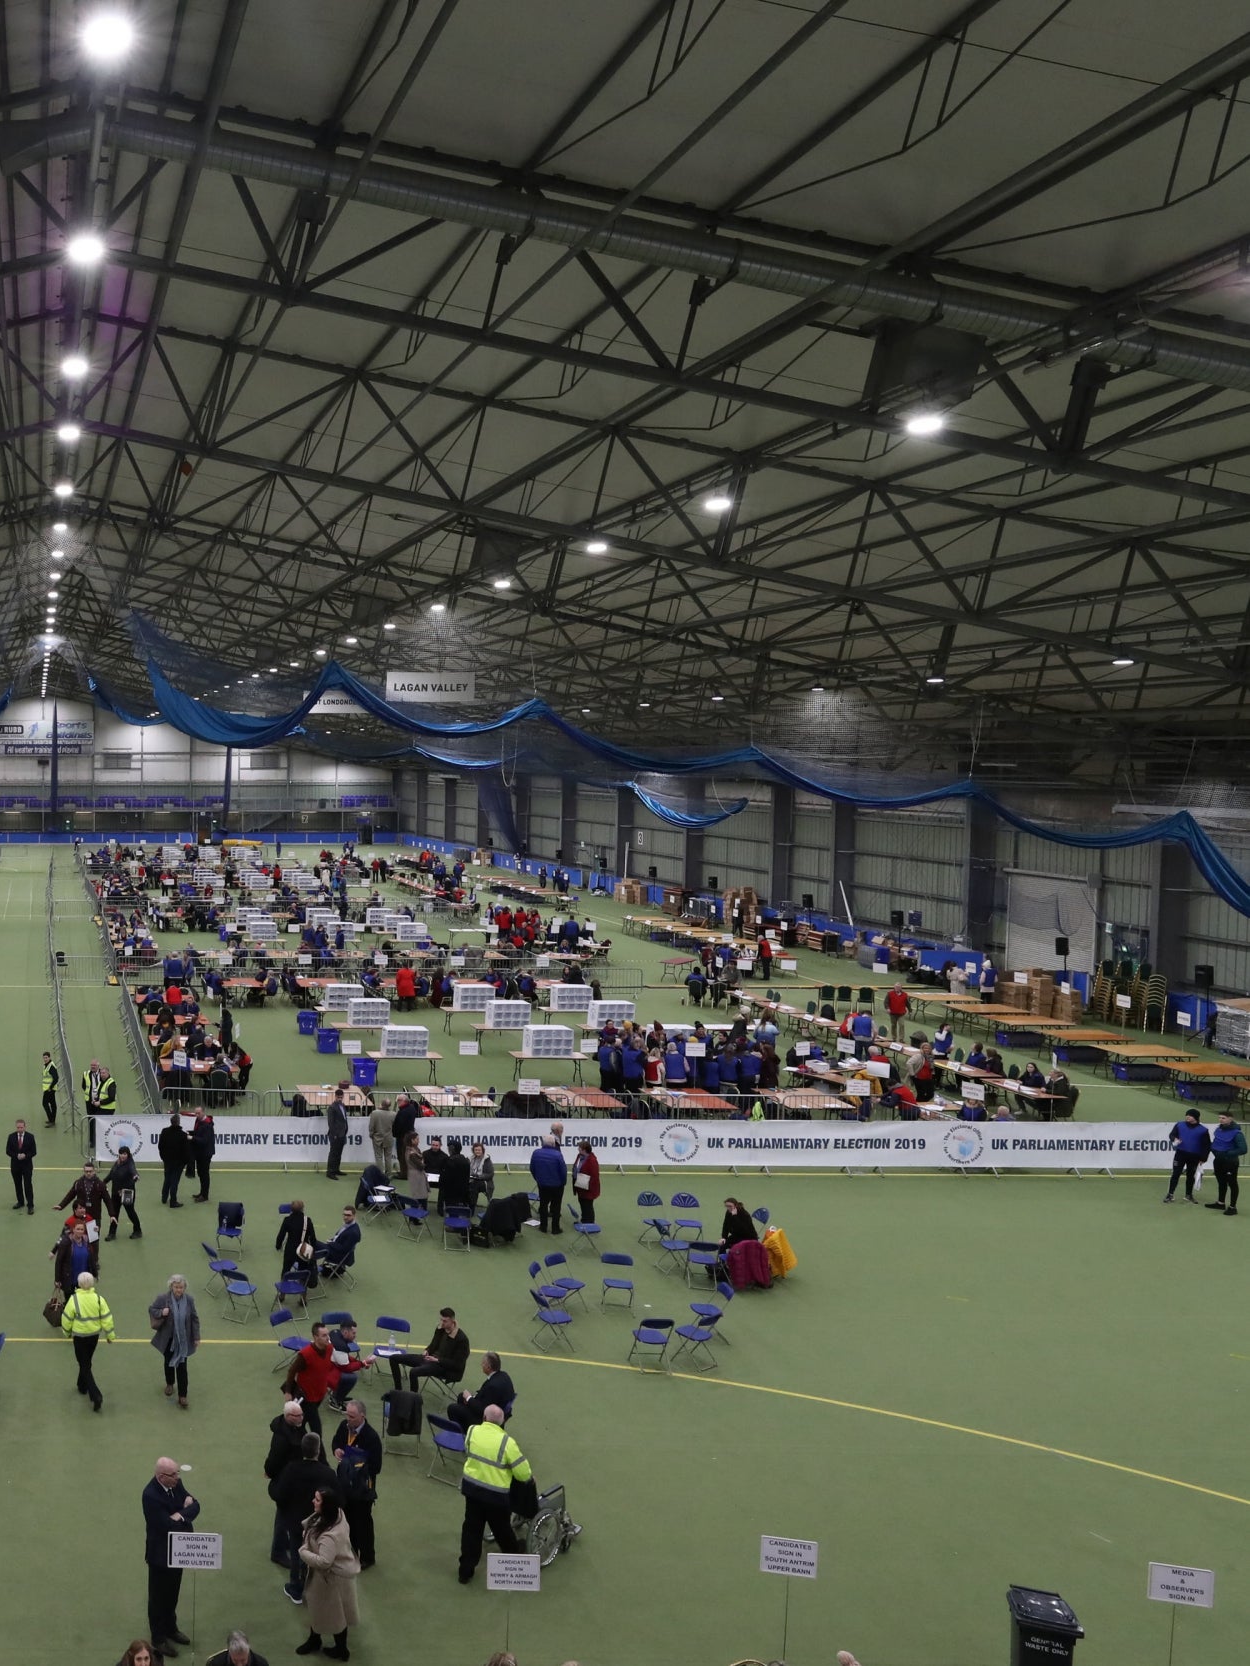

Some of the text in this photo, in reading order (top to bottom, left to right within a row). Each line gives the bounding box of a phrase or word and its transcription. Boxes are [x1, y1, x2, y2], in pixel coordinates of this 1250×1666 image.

[394, 683, 468, 692] LAGAN VALLEY
[151, 1134, 159, 1144] U
[214, 1134, 268, 1145] MENTARY
[273, 1134, 328, 1145] ELECTION
[612, 1137, 642, 1148] 2019
[708, 1138, 926, 1149] UK PARLIAMENTARY ELECTION 2019
[992, 1139, 1008, 1150] UK
[1013, 1139, 1115, 1151] PARLIAMENTARY
[769, 1540, 812, 1550] CANDIDATES
[1160, 1584, 1204, 1595] OBSERVERS
[1025, 1642, 1049, 1652] WASTE
[1031, 1636, 1064, 1648] GENERAL
